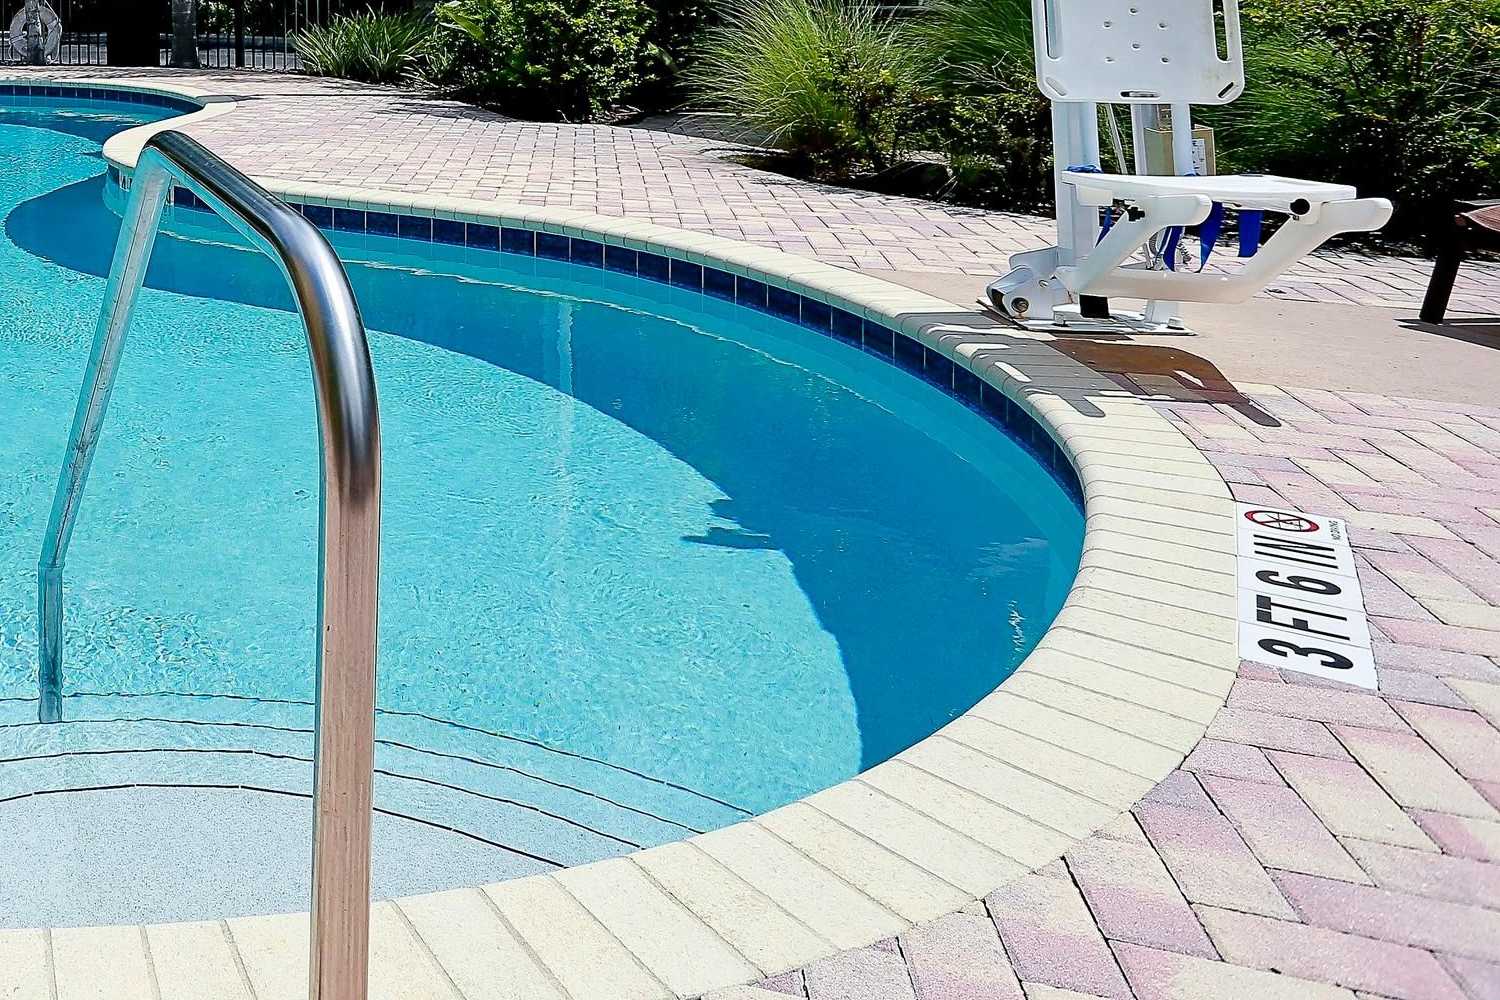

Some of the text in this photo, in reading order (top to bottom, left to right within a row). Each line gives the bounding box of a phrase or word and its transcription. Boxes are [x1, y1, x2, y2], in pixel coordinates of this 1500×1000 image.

[1253, 534, 1354, 670] 3 FT 6 IN
